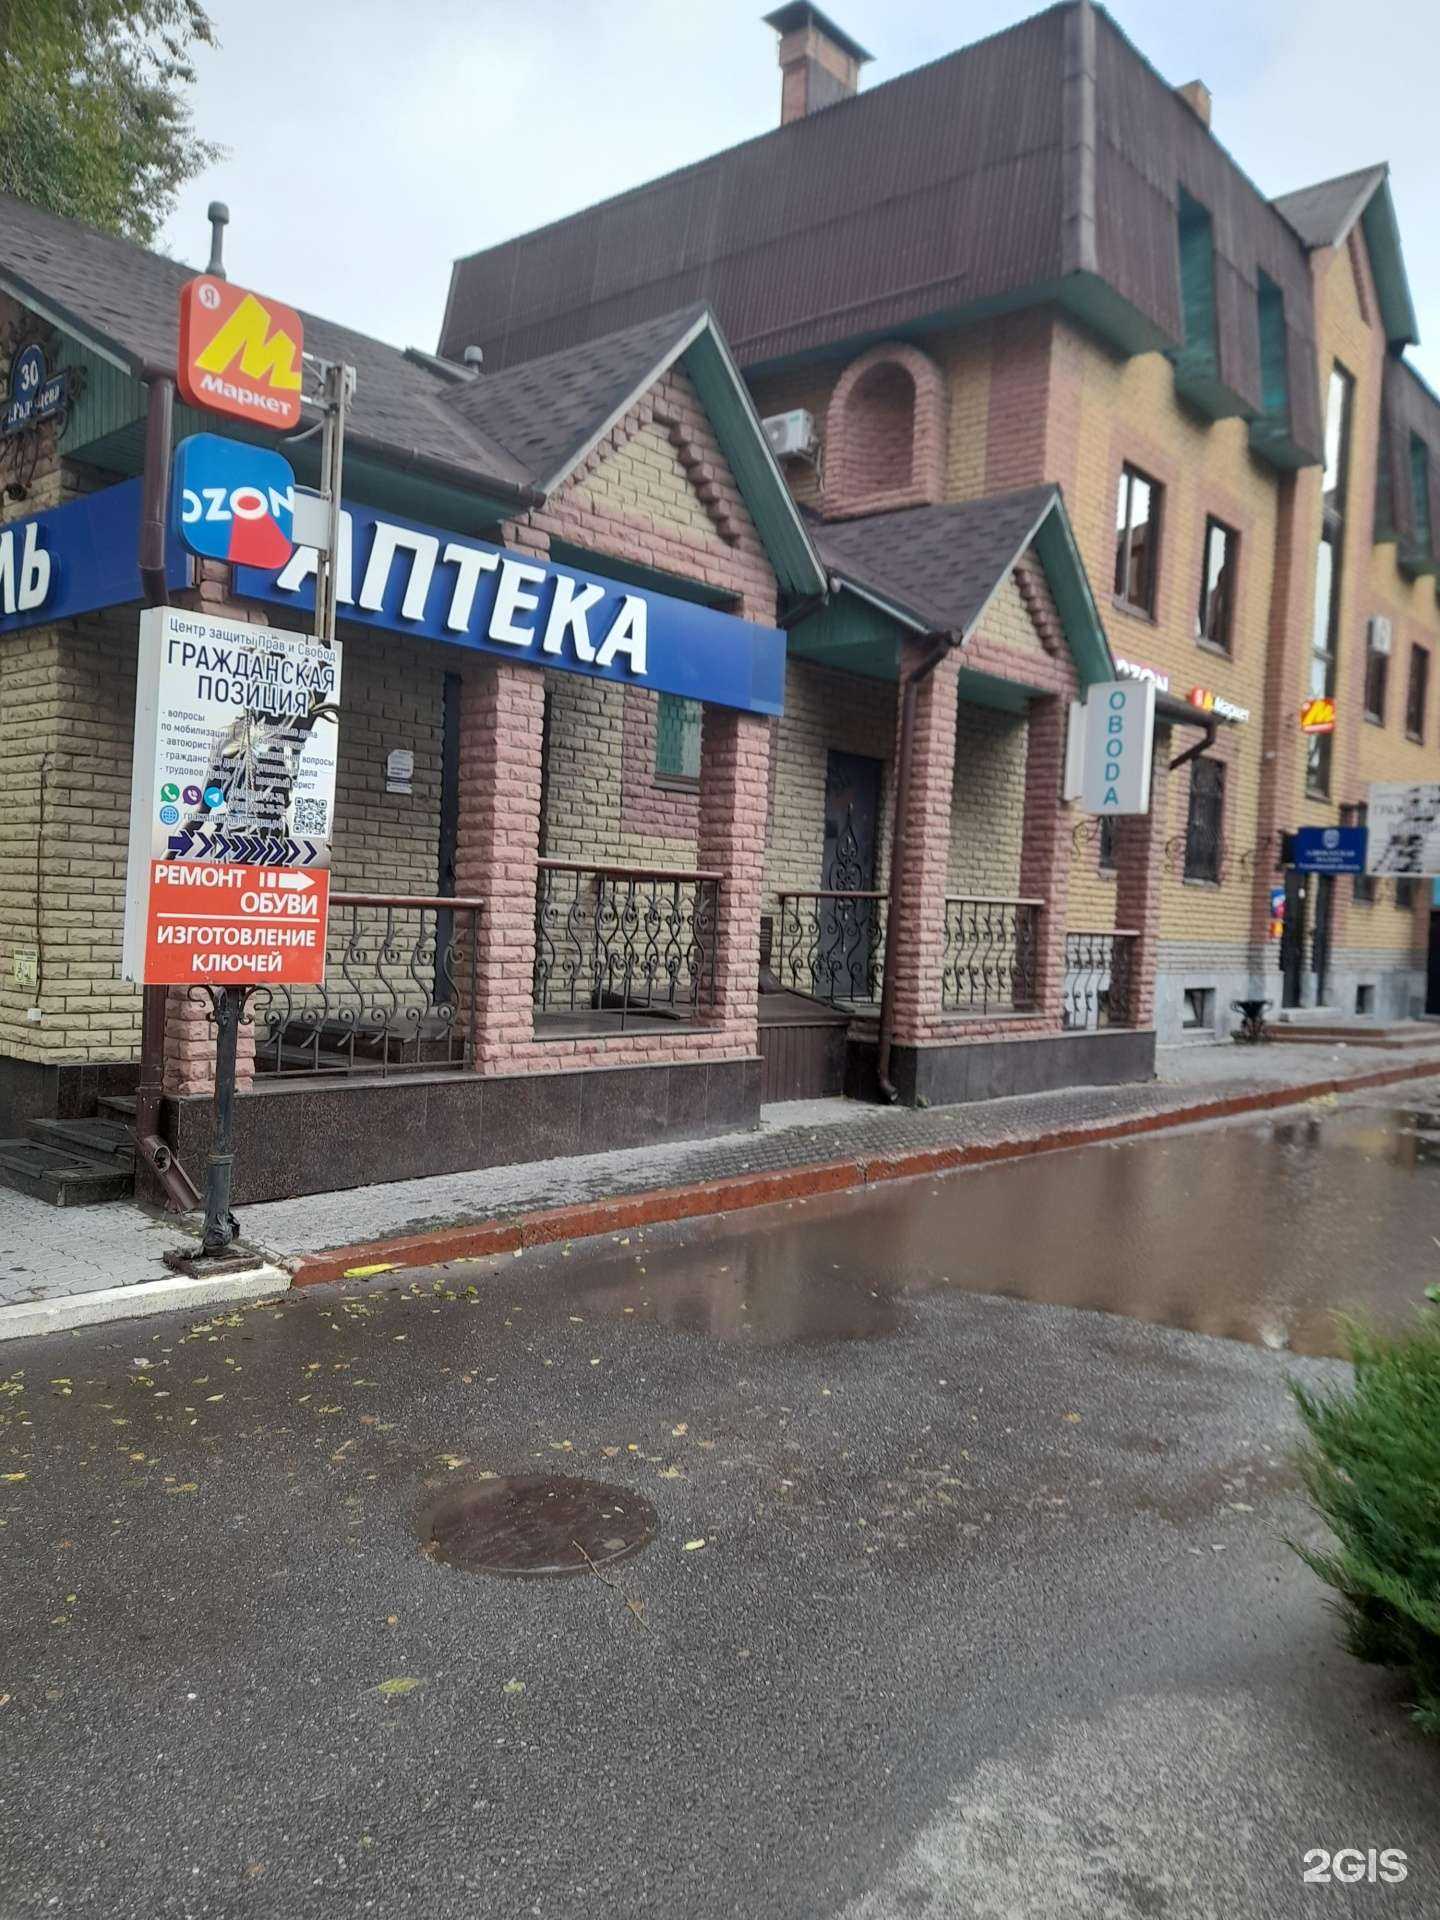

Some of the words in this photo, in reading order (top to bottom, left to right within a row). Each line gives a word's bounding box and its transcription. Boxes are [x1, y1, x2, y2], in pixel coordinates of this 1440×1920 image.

[21, 360, 39, 391] 30
[200, 373, 293, 417] Маркет
[182, 486, 295, 524] OZON
[276, 507, 649, 677] АПТЕКА
[169, 617, 206, 638] Центр
[208, 627, 256, 647] защиты
[258, 635, 285, 652] Прав
[288, 642, 295, 653] и
[297, 643, 336, 663] Свобод
[168, 639, 335, 692] ГРАЖДАНСКАЯ
[198, 674, 307, 715] ПОЗИЦИЯ
[168, 709, 205, 722] вопросы
[161, 722, 171, 732] по
[174, 725, 231, 739] мобилизации
[166, 737, 218, 751] автоюристы
[1104, 691, 1126, 805] OBODA
[165, 765, 204, 778] трудовое
[299, 768, 318, 778] дела
[302, 756, 335, 767] вопросы
[155, 864, 247, 889] РЕМОНТ
[240, 892, 318, 915] ОБУВИ
[157, 925, 317, 947] ИЗГОТОВЛЕНИЕ
[191, 951, 283, 973] КЛЮЧЕЙ
